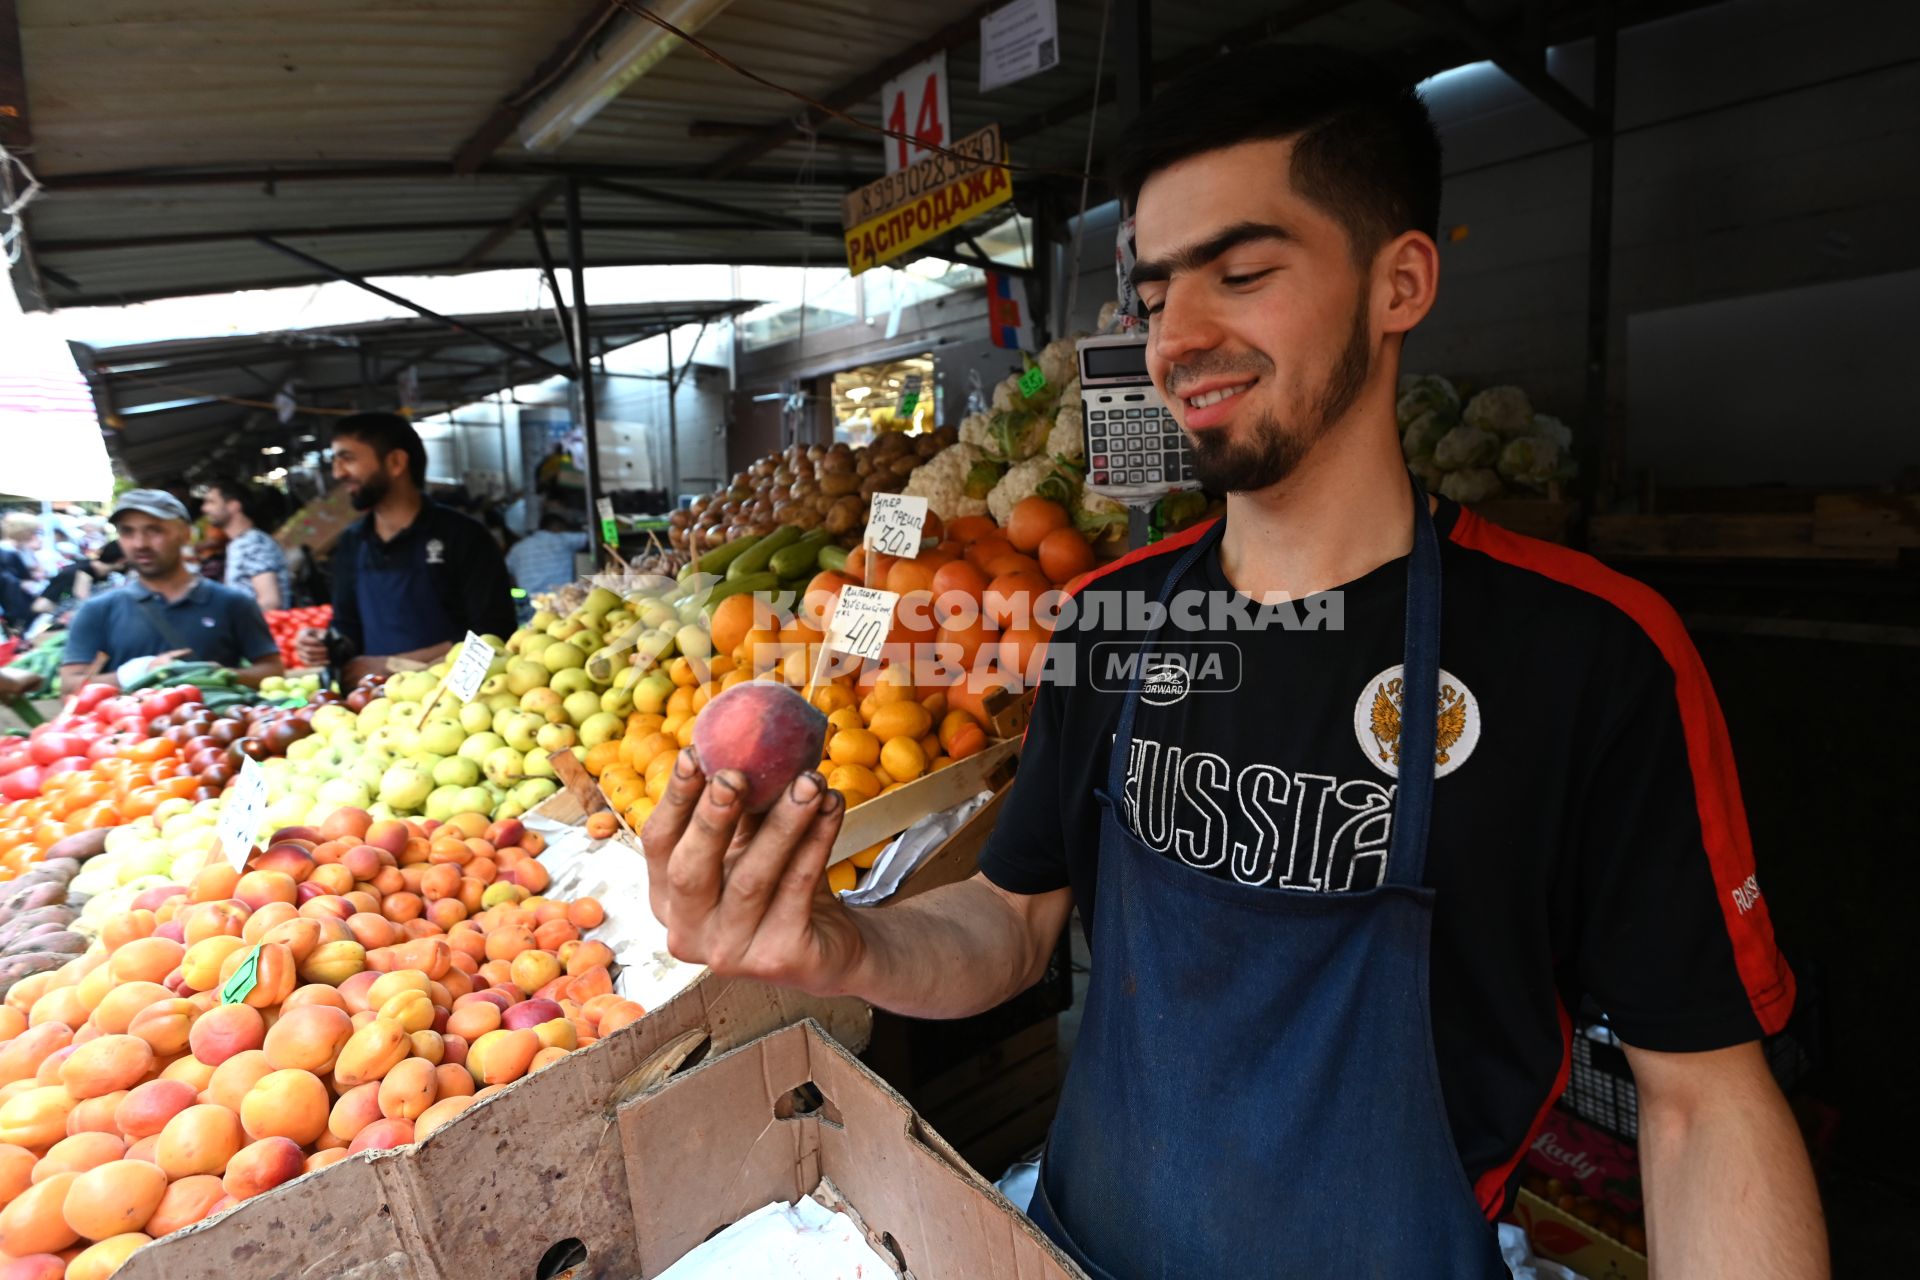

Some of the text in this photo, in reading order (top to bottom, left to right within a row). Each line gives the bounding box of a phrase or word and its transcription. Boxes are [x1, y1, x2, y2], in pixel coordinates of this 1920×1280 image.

[889, 72, 944, 169] 14
[850, 166, 1008, 267] РАСПРОДАЖА
[1530, 1132, 1597, 1180] Lady
